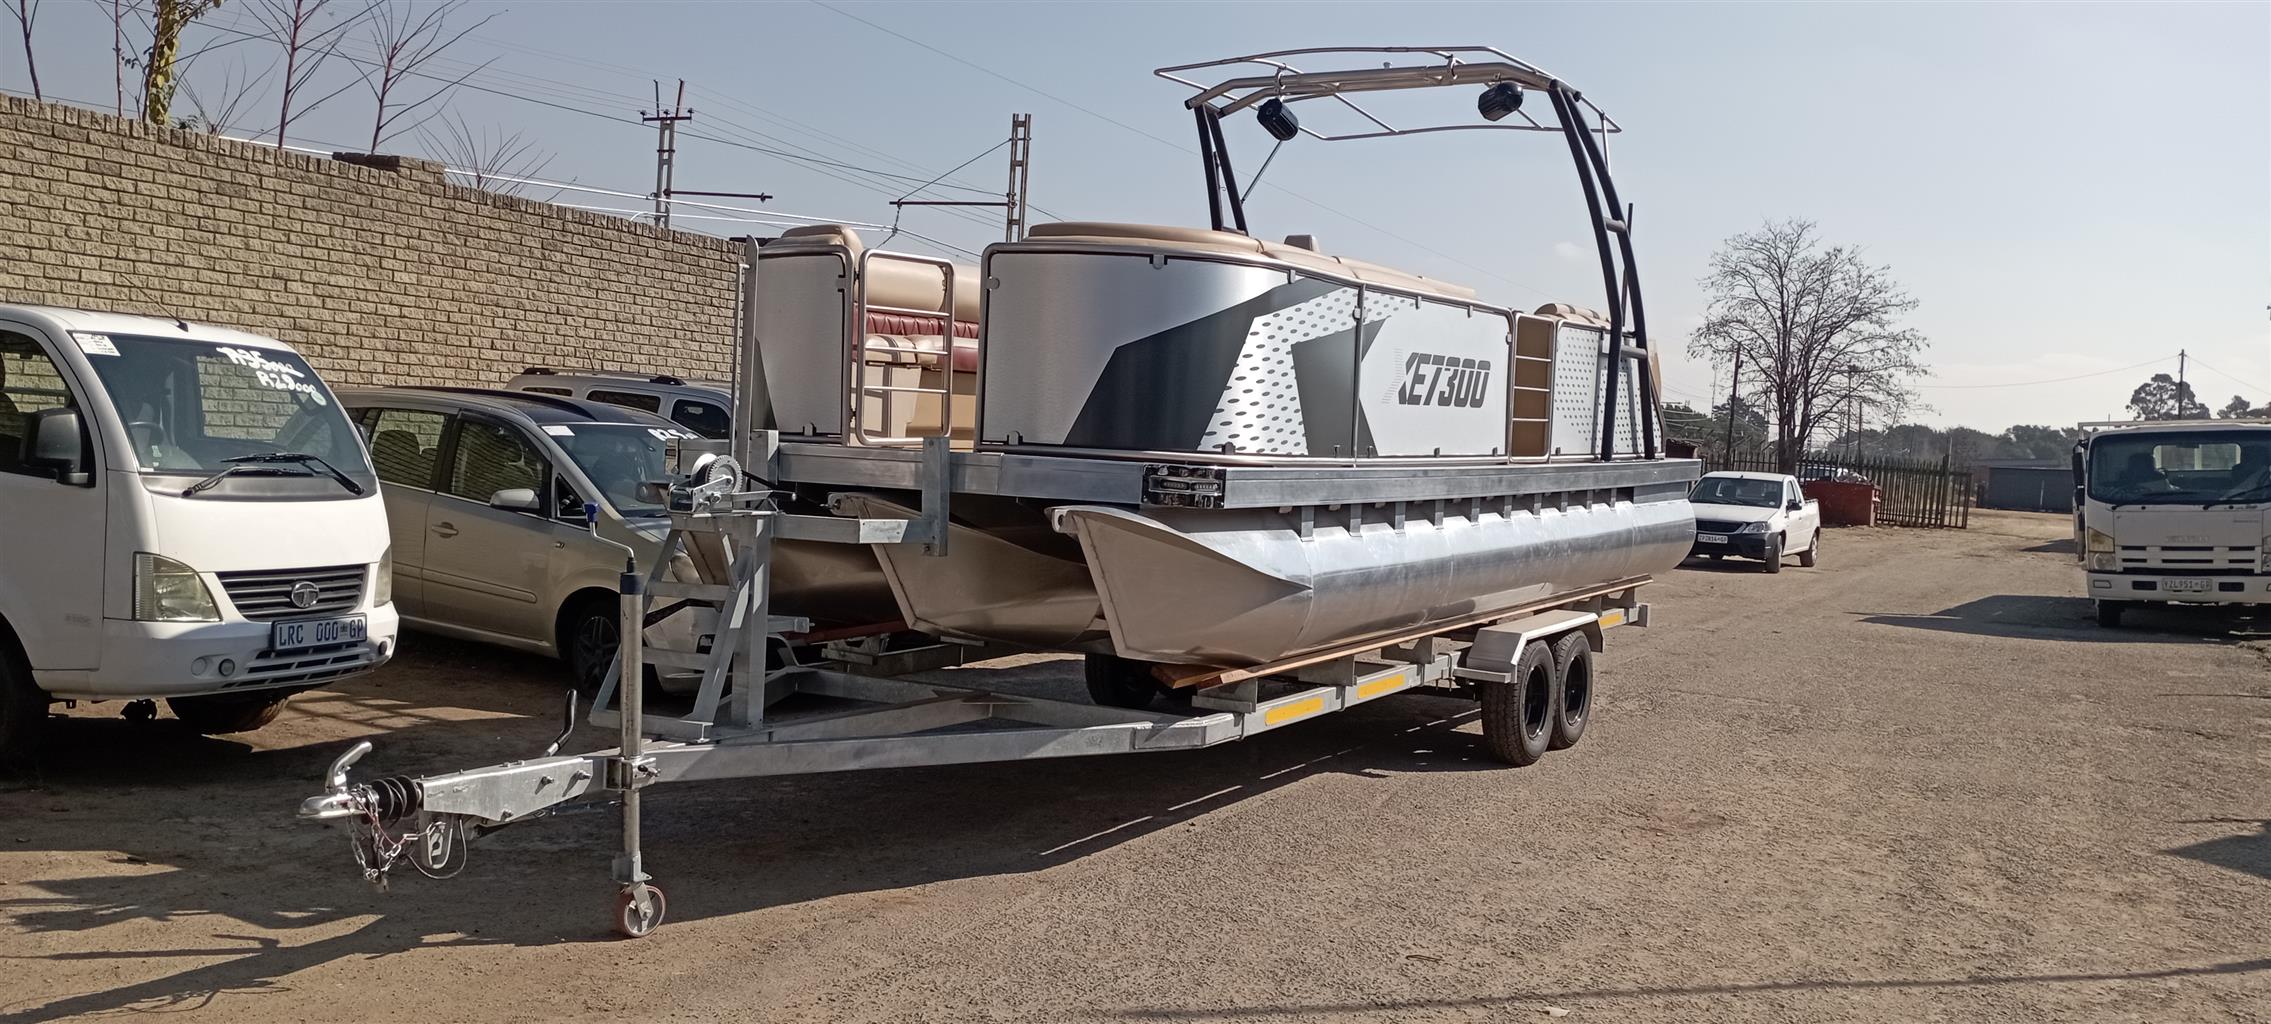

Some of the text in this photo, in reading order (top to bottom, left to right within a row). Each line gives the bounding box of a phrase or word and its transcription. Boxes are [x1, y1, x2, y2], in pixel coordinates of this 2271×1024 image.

[279, 618, 363, 646] LRC 000 GP
